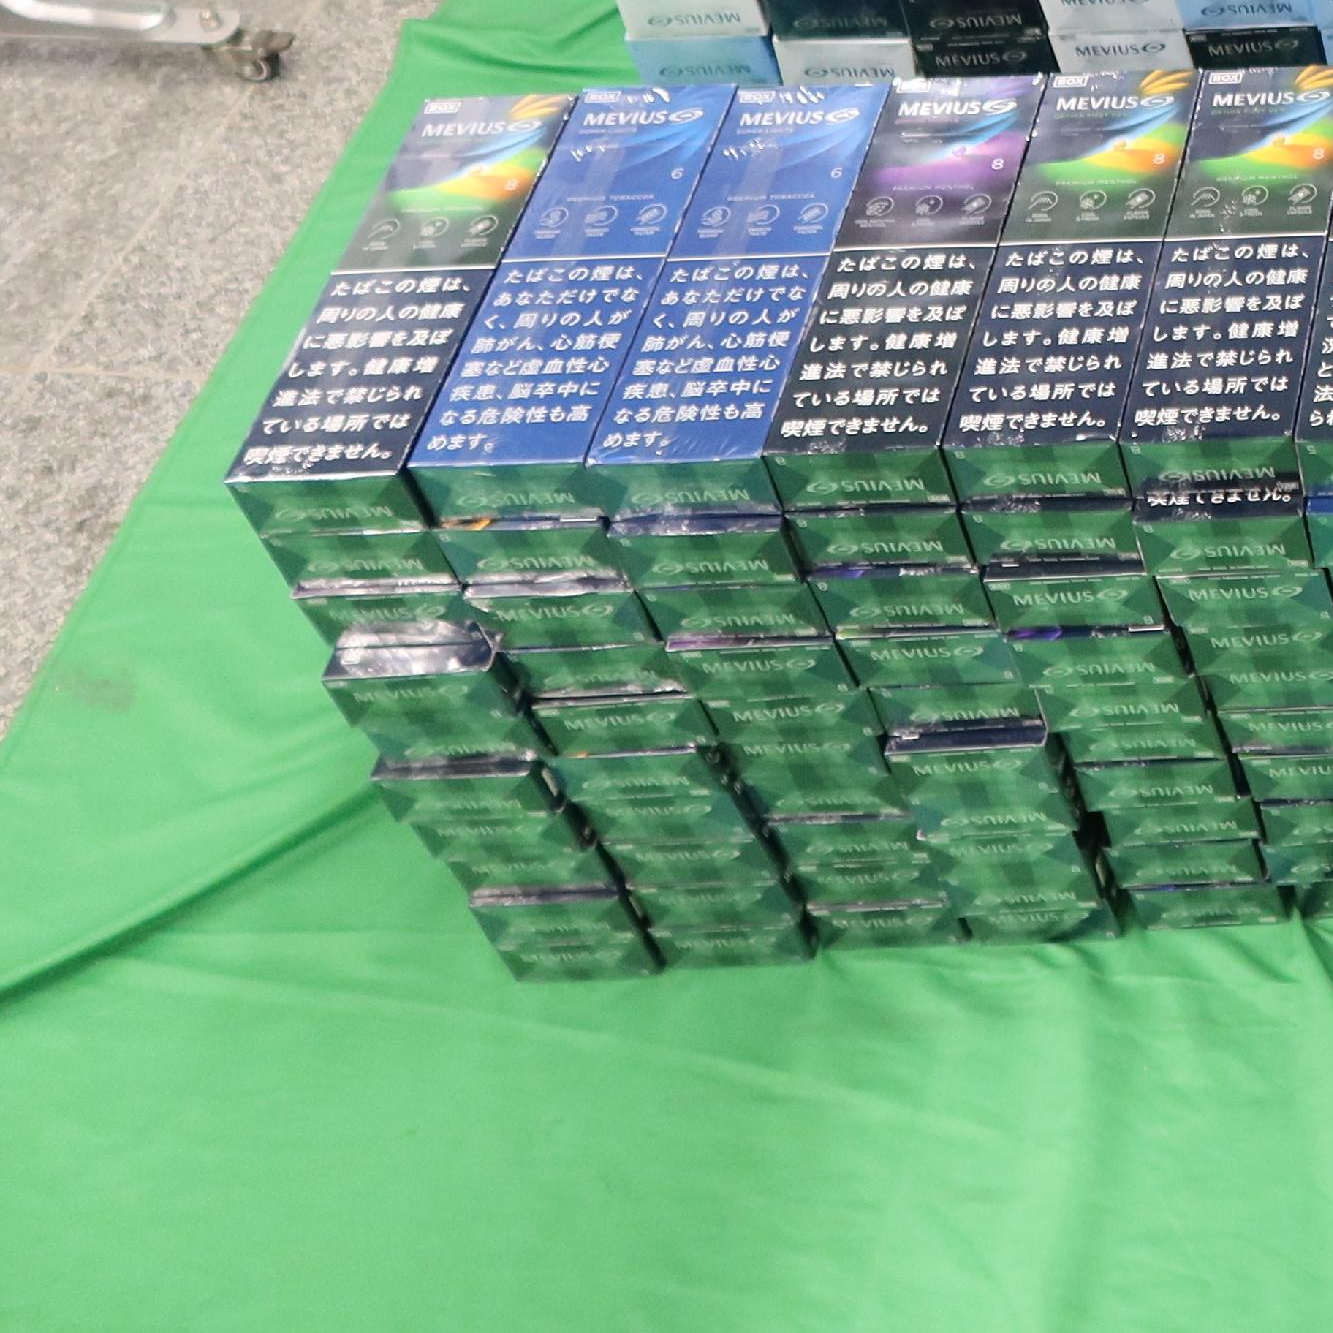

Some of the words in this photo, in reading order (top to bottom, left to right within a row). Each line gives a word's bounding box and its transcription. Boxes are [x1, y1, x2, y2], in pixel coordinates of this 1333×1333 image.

[672, 12, 740, 26] MEVIUS
[1075, 43, 1140, 57] MEVIUS
[898, 101, 982, 116] MEVIUS
[1056, 96, 1138, 111] MEVIUS
[1212, 91, 1295, 107] MEVIUS
[583, 111, 667, 126] MEVIUS
[740, 111, 823, 126] MEVIUS
[422, 121, 505, 137] MEVIUS
[1153, 153, 1165, 164] 8
[1313, 148, 1325, 159] 8
[671, 167, 684, 180] 6
[830, 167, 843, 179] 6
[1006, 249, 1143, 266] たばこの煙は、
[1172, 243, 1308, 262] たばこの煙は、
[837, 254, 975, 272] たばこの煙は、
[504, 266, 643, 283] たばこの煙は、
[670, 264, 808, 282] たばこの煙は、
[1165, 269, 1308, 289] 周りの人の健康
[827, 280, 974, 299] 周りの人の健康
[998, 274, 1142, 293] 周りの人の健康
[493, 288, 639, 306] あなただけでな
[661, 286, 806, 304] あなただけでな
[1160, 294, 1304, 314] に悪影響を及ぼ
[484, 309, 632, 329] く、周りの人が
[654, 307, 800, 327] く、周りの人が
[819, 306, 966, 324] に悪影響を及ぼ
[991, 300, 1137, 319] に悪影響を及ぼ
[983, 327, 1129, 347] します。健康増
[1153, 320, 1298, 341] します。健康増
[471, 333, 621, 353] 肺がん、心筋梗
[641, 331, 790, 352] 肺がん、心筋梗
[810, 332, 958, 352] します。健康増
[461, 356, 609, 377] 塞など虚血性心
[632, 355, 780, 375] 塞など虚血性心
[974, 355, 1121, 375] 進法で禁じられ
[1147, 349, 1292, 369] 進法で禁じられ
[800, 360, 947, 380] 進法で禁じられ
[450, 381, 600, 401] 疾患、脳卒中に
[623, 379, 773, 399] 疾患、脳卒中に
[969, 383, 1116, 402] ている場所では
[1143, 376, 1288, 396] ている場所では
[793, 387, 940, 407] ている場所では
[440, 404, 592, 426] なる危険性も高
[614, 402, 765, 423] なる危険性も高
[960, 411, 1106, 432] 喫煙できません。
[1135, 404, 1280, 426] 喫煙できません。
[781, 416, 928, 437] 喫煙できません。
[428, 433, 494, 452] めます。
[603, 432, 670, 448] めます。
[1018, 469, 1101, 487] MEVIUS
[1012, 589, 1095, 608] MEVIUS
[1189, 584, 1270, 601] MEVIUS
[496, 605, 578, 621] MEVIUS
[702, 656, 783, 675] MEVIUS
